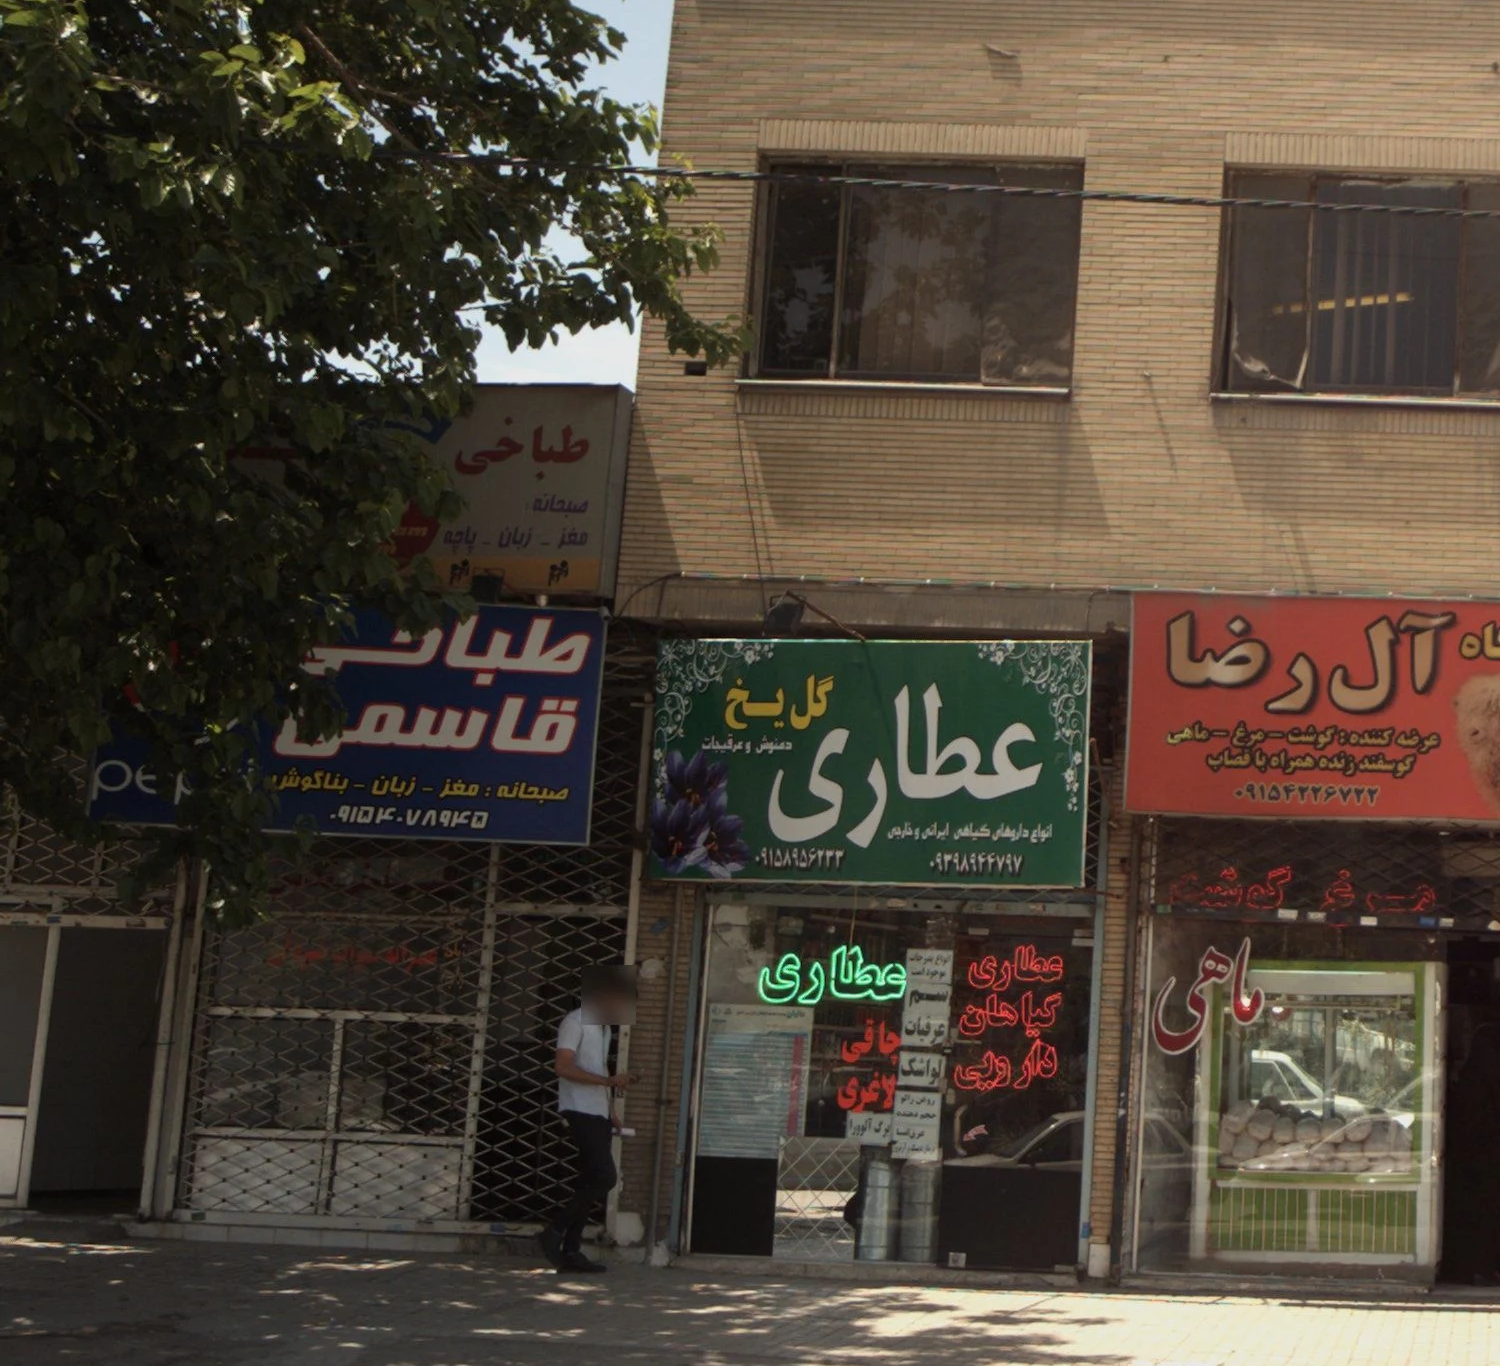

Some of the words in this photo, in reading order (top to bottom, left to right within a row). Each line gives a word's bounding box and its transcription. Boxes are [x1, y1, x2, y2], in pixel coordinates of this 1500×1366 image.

[454, 416, 590, 481] طباخی
[532, 493, 589, 518] صبحانه
[498, 524, 532, 550] زبان
[558, 527, 588, 549] مغز
[1165, 610, 1318, 716] رضا
[1328, 610, 1458, 715] آل
[725, 677, 785, 730] یخ
[789, 673, 835, 730] گل
[273, 694, 579, 757] قاسمی
[1166, 722, 1209, 745] ماهی
[1232, 722, 1265, 747] مرغ
[1288, 725, 1335, 750] گوشت
[1348, 726, 1394, 747] کننده
[756, 734, 793, 754] دمنوش
[1397, 728, 1440, 753] عرضه
[767, 683, 1043, 850] عطاری
[1206, 749, 1251, 772] قصاب
[1255, 752, 1267, 771] با
[1270, 749, 1314, 774] همراه
[1318, 752, 1356, 775] زنده
[1359, 753, 1417, 777] گوسفند
[371, 775, 417, 797] زبان
[439, 778, 479, 798] مغز
[497, 781, 569, 803] صبحانه
[887, 821, 913, 840] خارجی
[921, 822, 950, 840] ایرانی
[992, 822, 1029, 842] داروهای
[1029, 823, 1053, 843] انواع
[758, 943, 907, 1004] عطاری
[968, 945, 1065, 990] عطاری
[1152, 937, 1265, 1055] ماهی
[959, 990, 1062, 1038] گیاهان
[842, 1019, 902, 1065] چاقی
[900, 1057, 943, 1085] لواشک
[954, 1038, 1058, 1092] دارویی
[837, 1071, 897, 1113] لاغری
